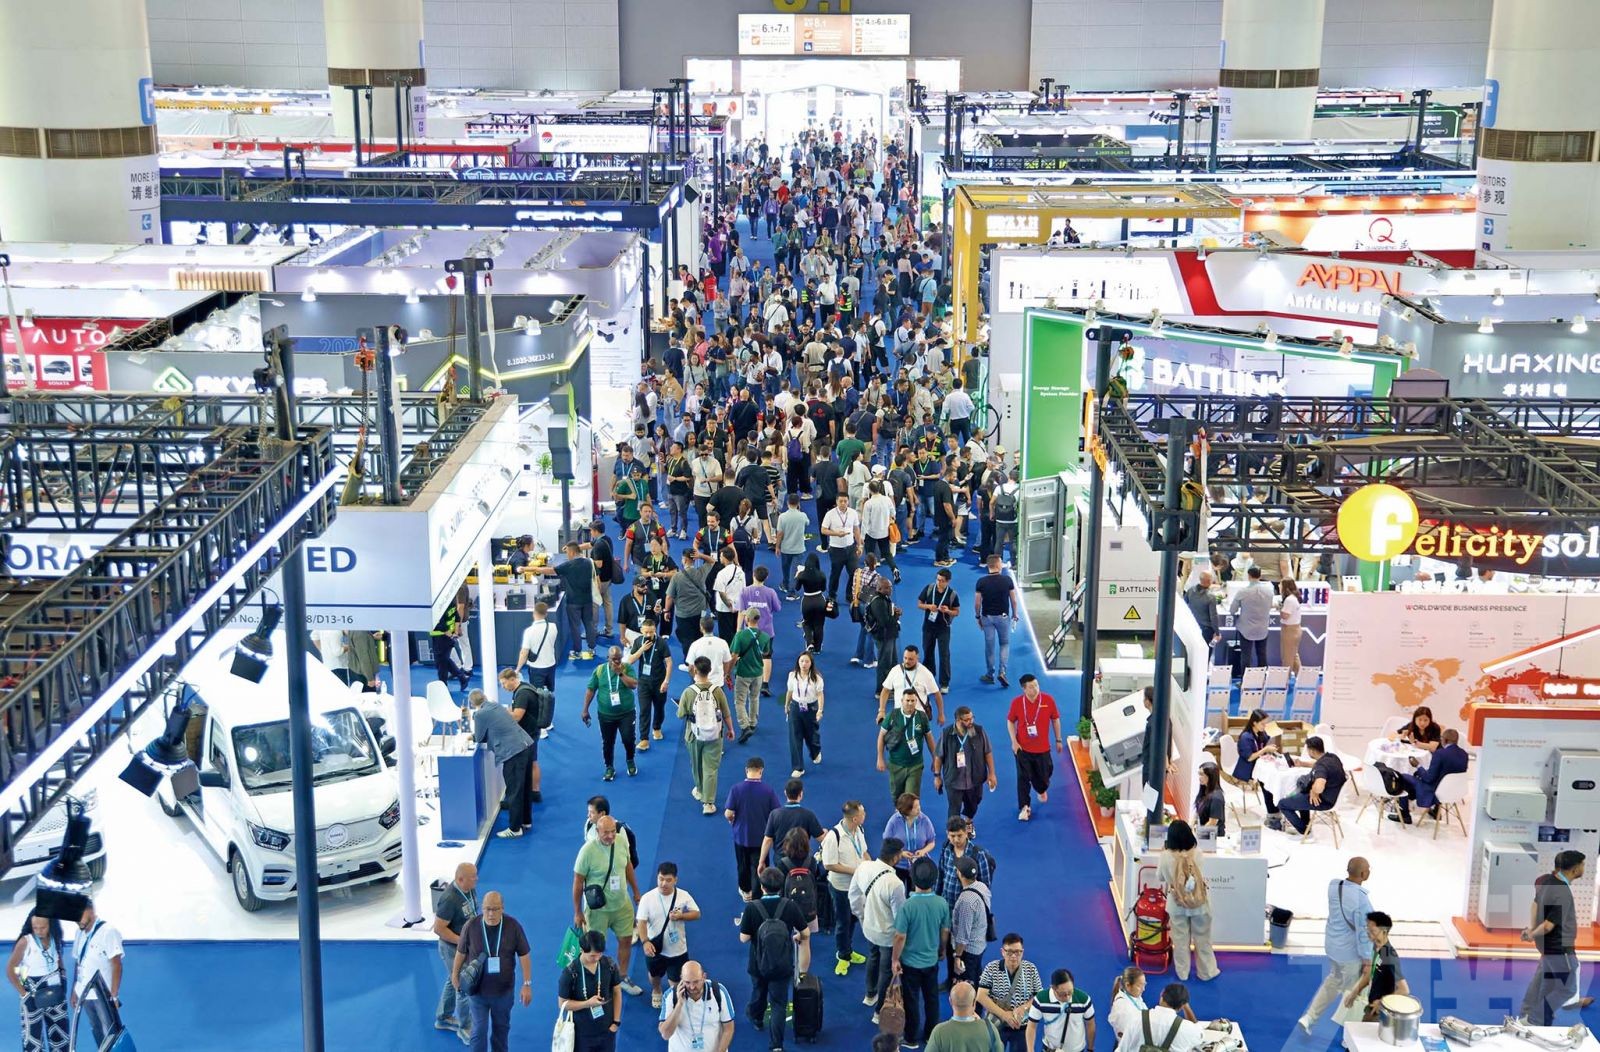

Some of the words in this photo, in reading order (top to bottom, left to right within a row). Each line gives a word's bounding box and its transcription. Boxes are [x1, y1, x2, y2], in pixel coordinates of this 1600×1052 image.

[130, 172, 150, 183] MORE
[1363, 301, 1381, 317] En
[1152, 357, 1291, 398] BATTLINK
[306, 614, 354, 624] 8/D13-16
